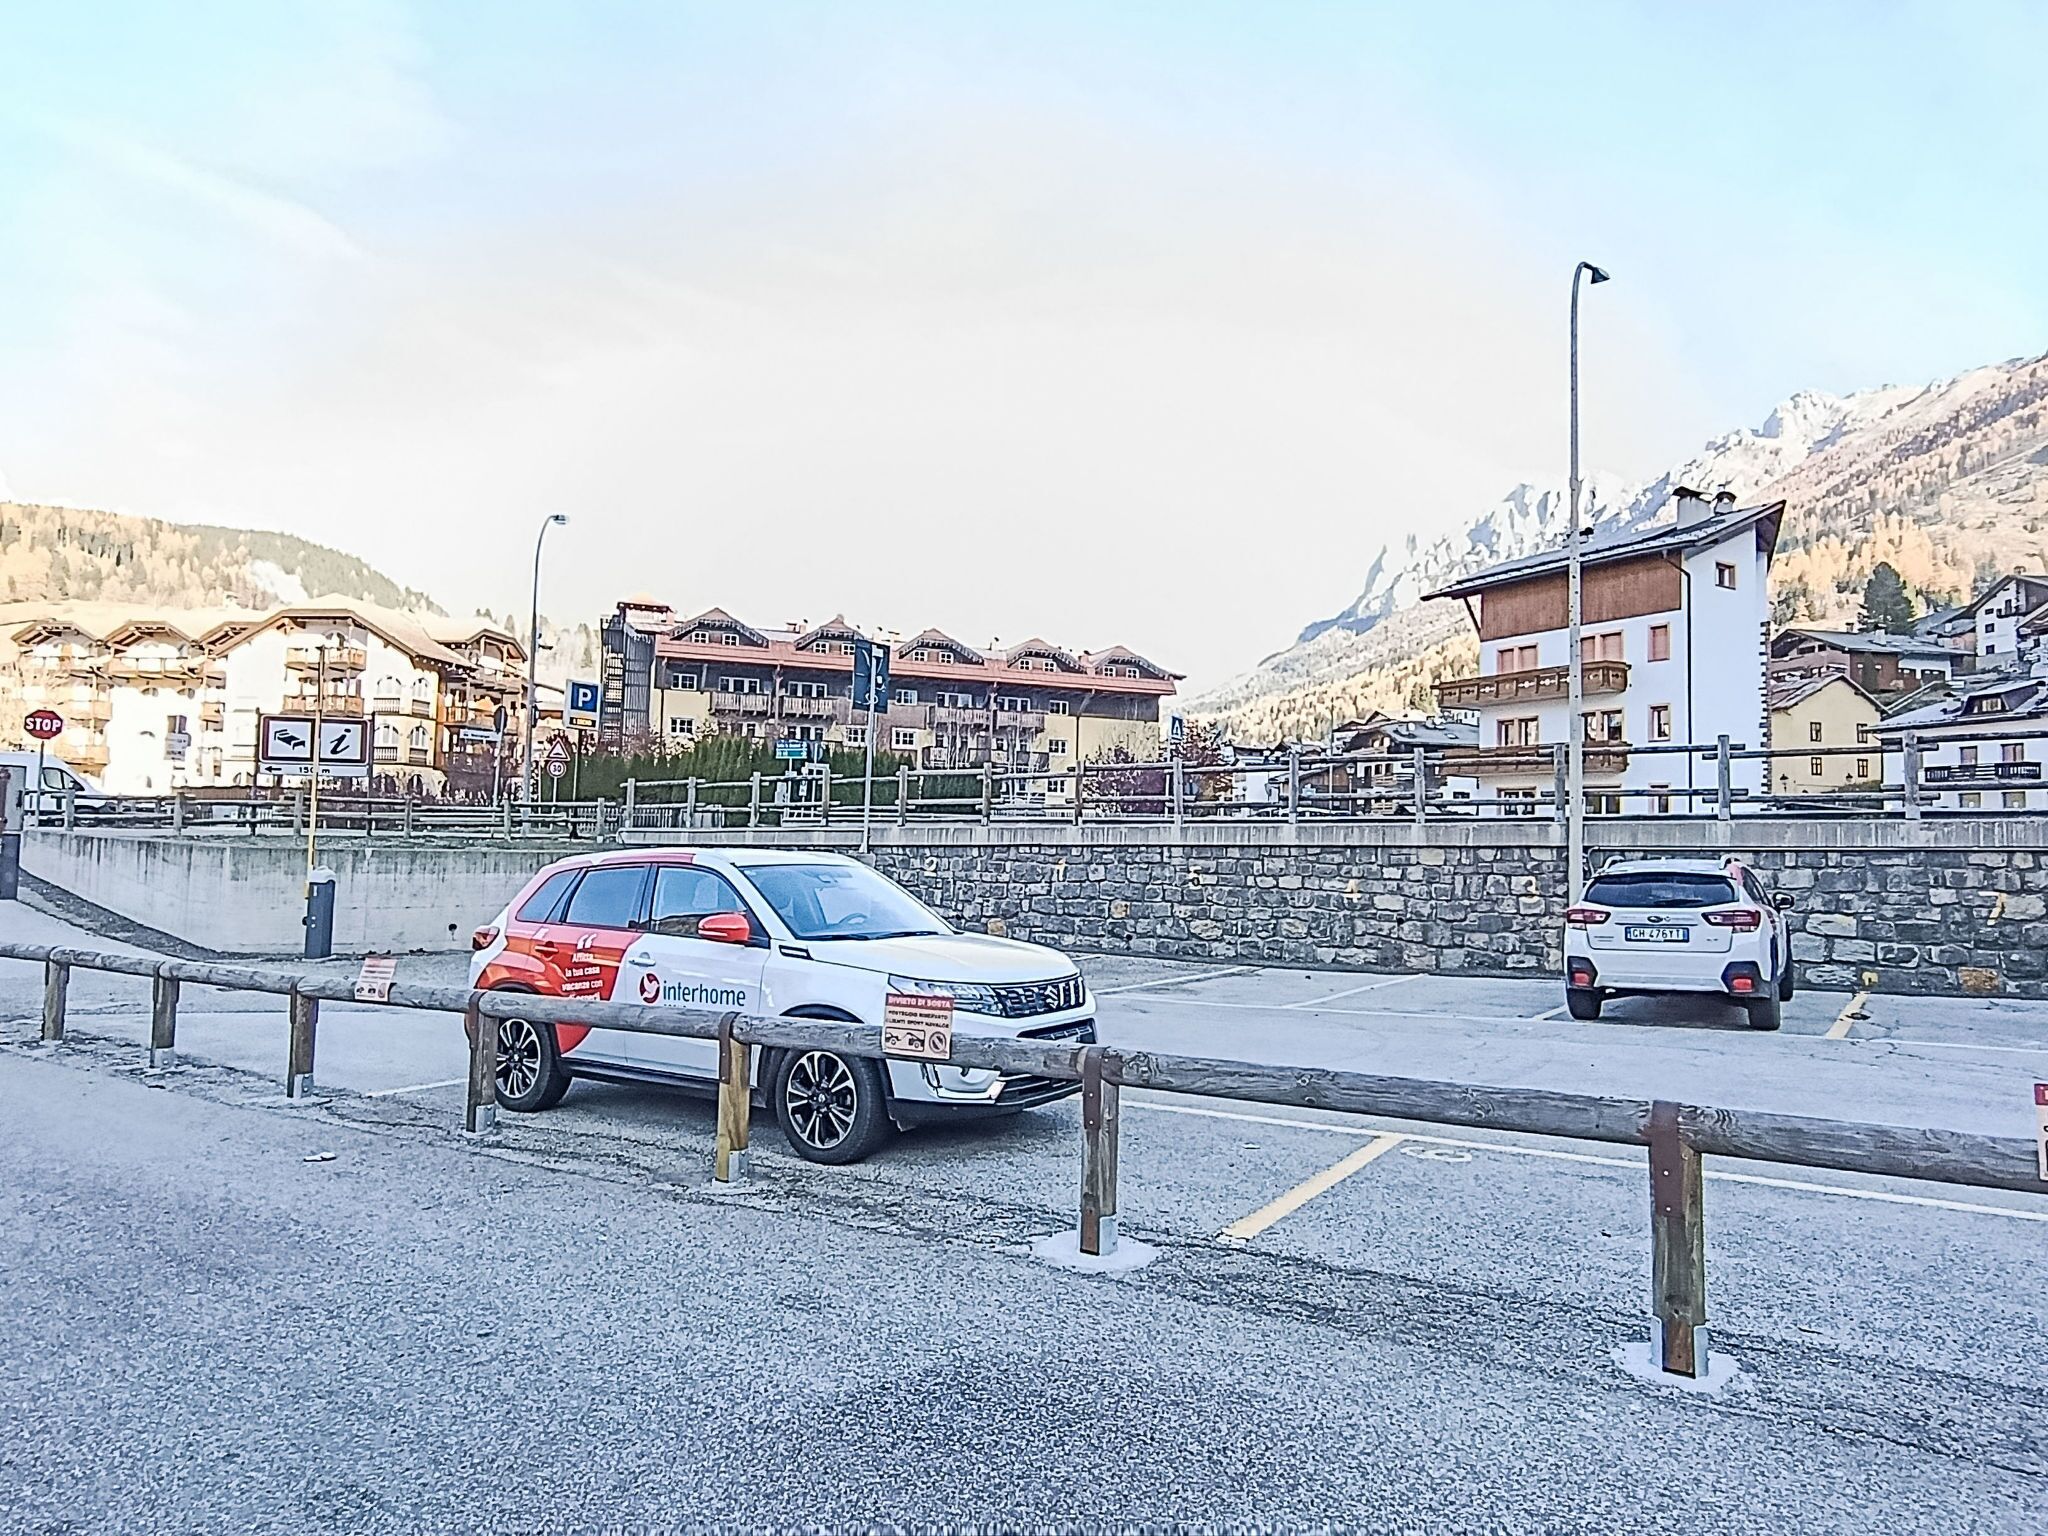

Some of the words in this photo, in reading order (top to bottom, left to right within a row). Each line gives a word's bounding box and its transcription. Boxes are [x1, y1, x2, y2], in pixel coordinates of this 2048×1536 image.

[578, 687, 592, 708] P
[25, 717, 62, 732] STOP
[552, 764, 562, 773] 30
[663, 980, 746, 1007] interhome
[888, 996, 917, 1006] DIVIETO
[926, 999, 951, 1008] SOSTA
